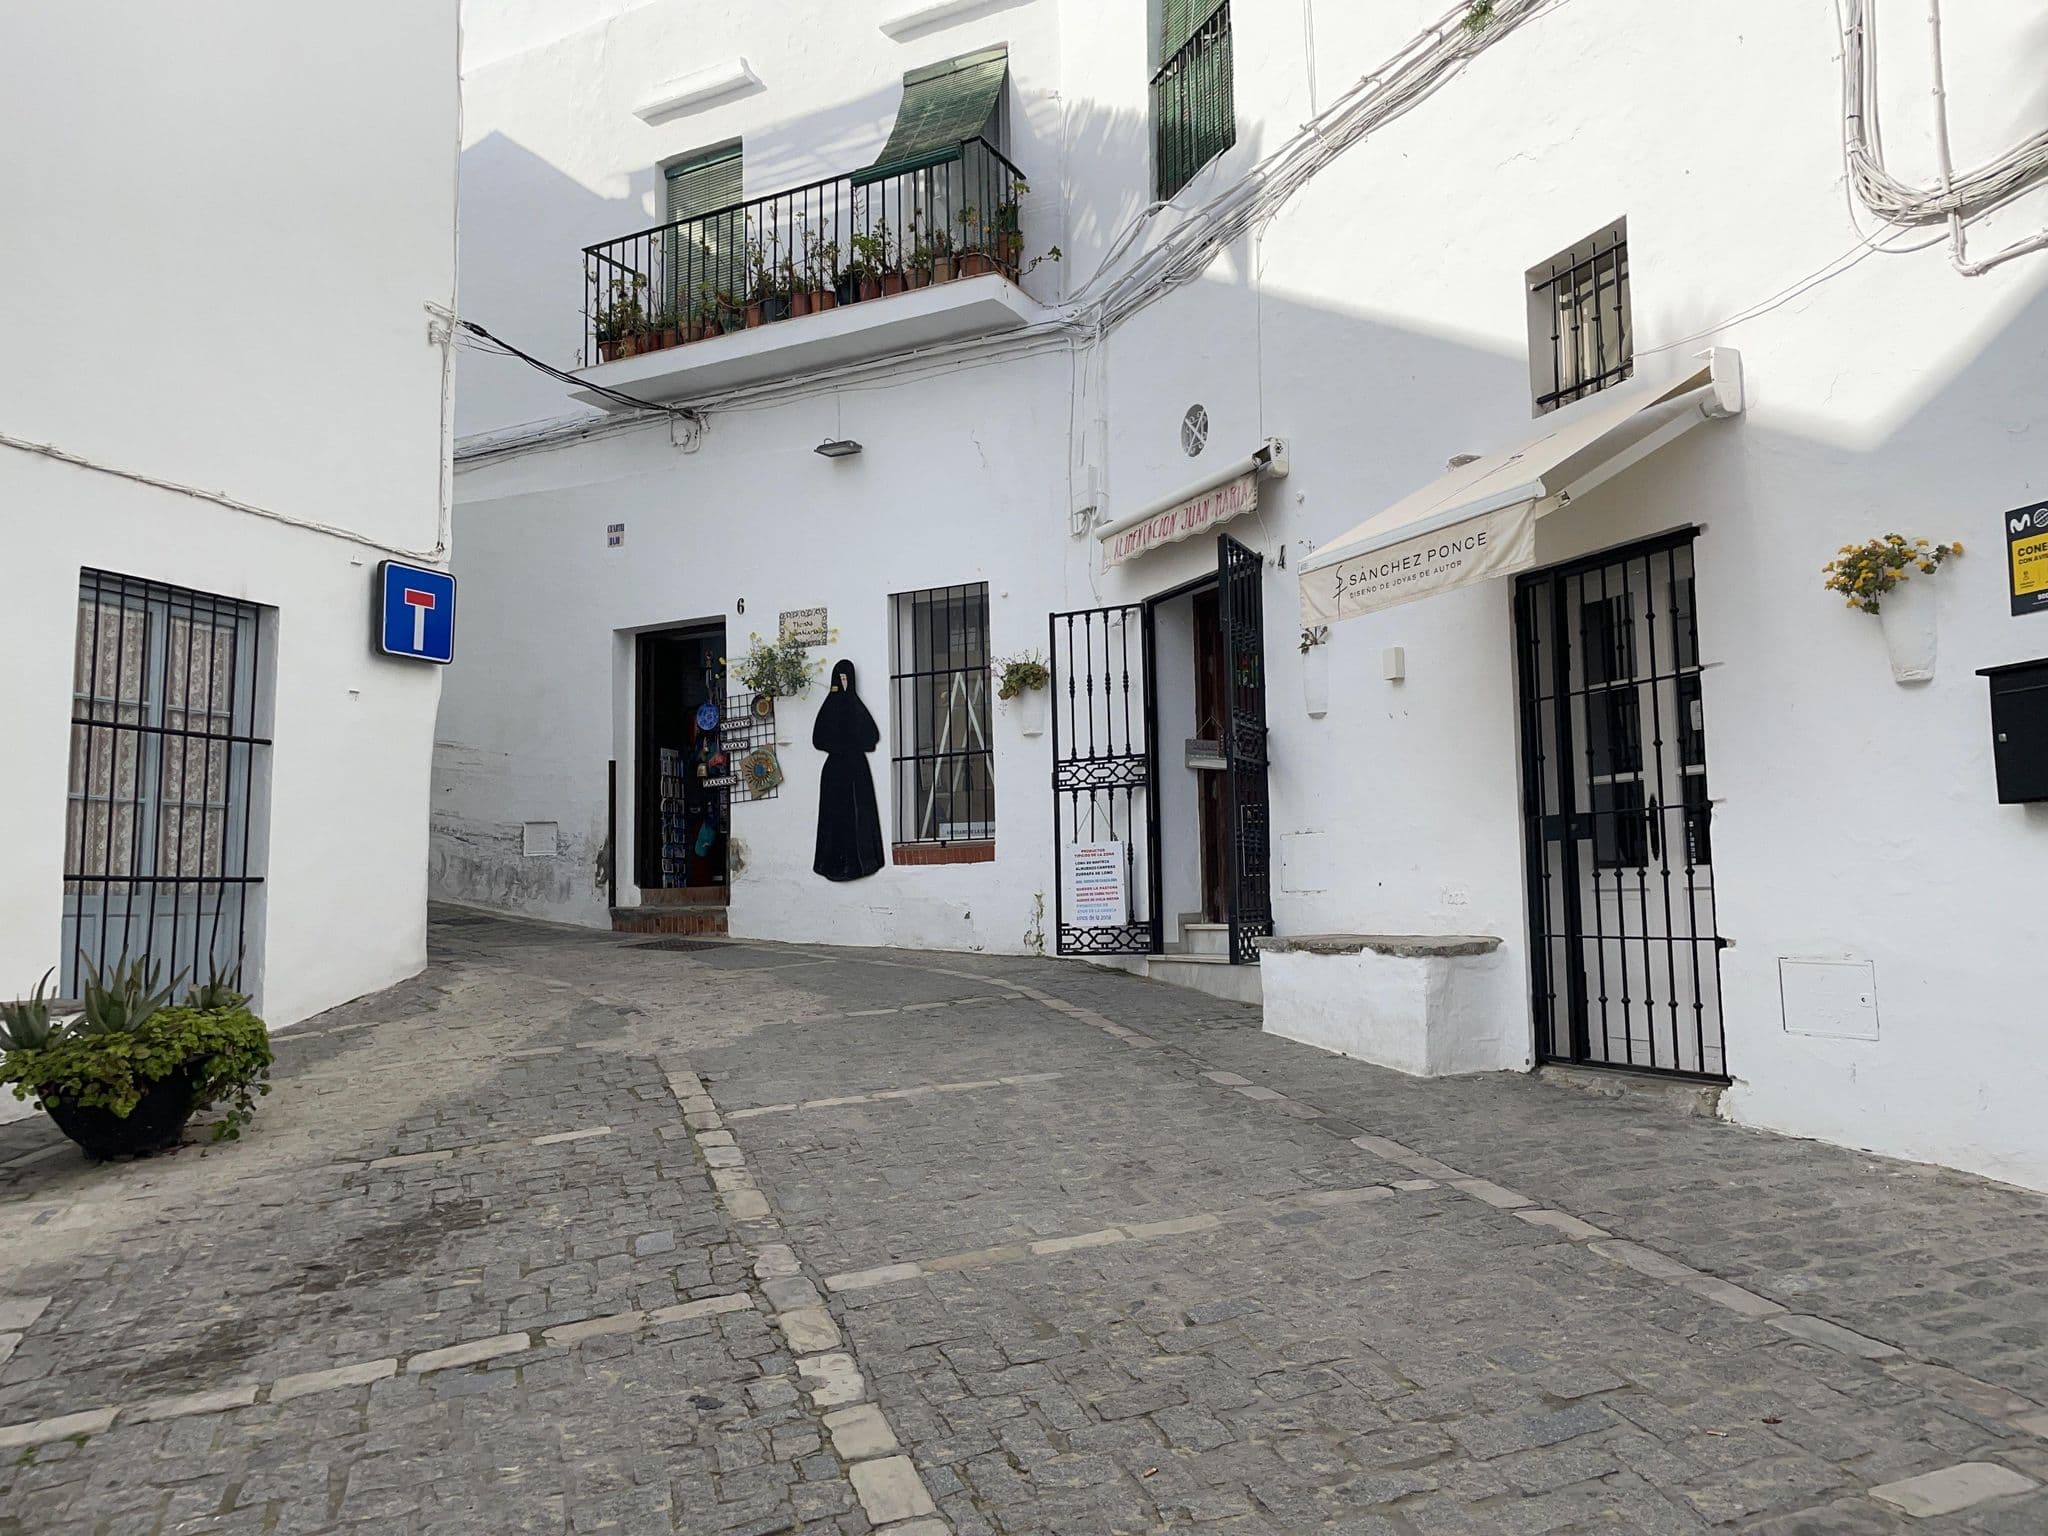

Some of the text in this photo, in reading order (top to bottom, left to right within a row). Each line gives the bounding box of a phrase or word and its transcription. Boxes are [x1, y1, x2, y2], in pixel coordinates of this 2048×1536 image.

[1180, 498, 1210, 530] JUAN
[1277, 544, 1285, 569] 4
[1349, 531, 1488, 586] SÁNCHEZ PONCE
[1379, 582, 1390, 591] DE
[1392, 574, 1417, 587] JOYAS
[1419, 569, 1431, 578] DE
[1433, 560, 1462, 574] AUTOR
[736, 597, 745, 615] 6
